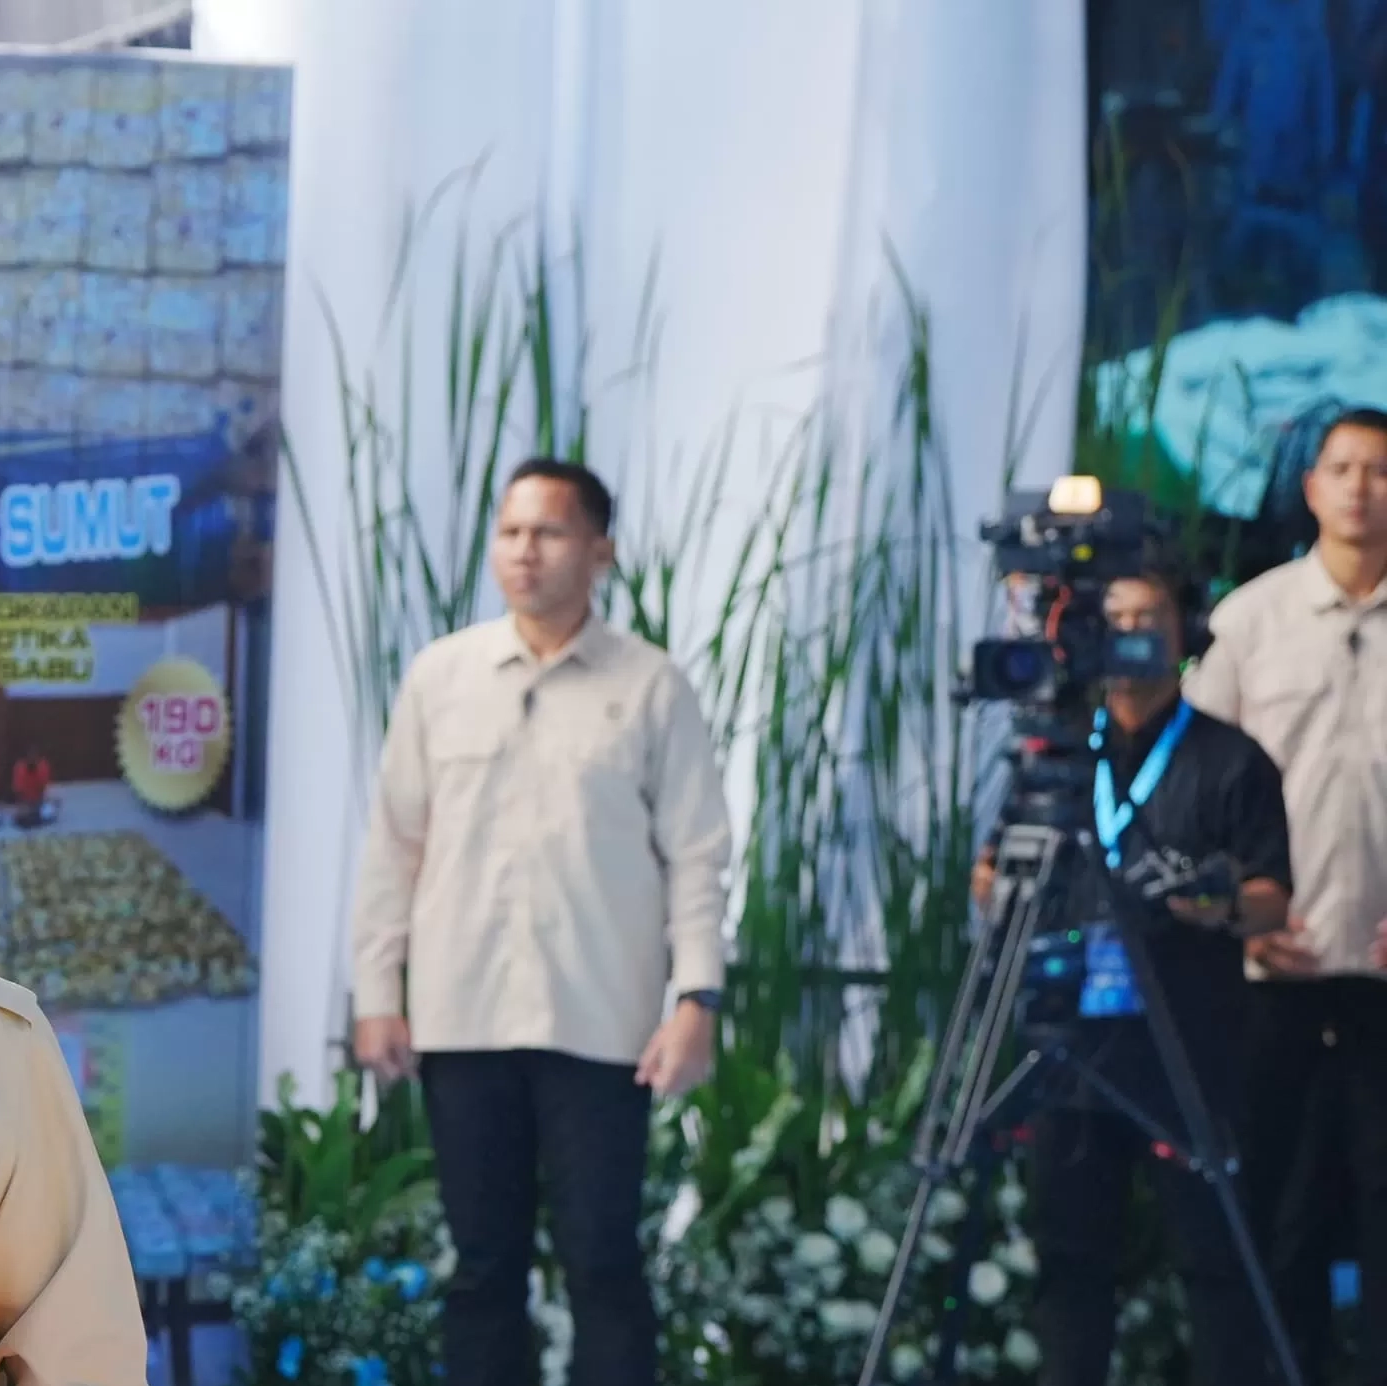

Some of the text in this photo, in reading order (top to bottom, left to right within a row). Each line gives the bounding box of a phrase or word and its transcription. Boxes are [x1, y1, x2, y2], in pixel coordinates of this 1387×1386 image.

[0, 477, 175, 566] SUMUT
[0, 655, 92, 682] SABU
[141, 696, 220, 735] 190
